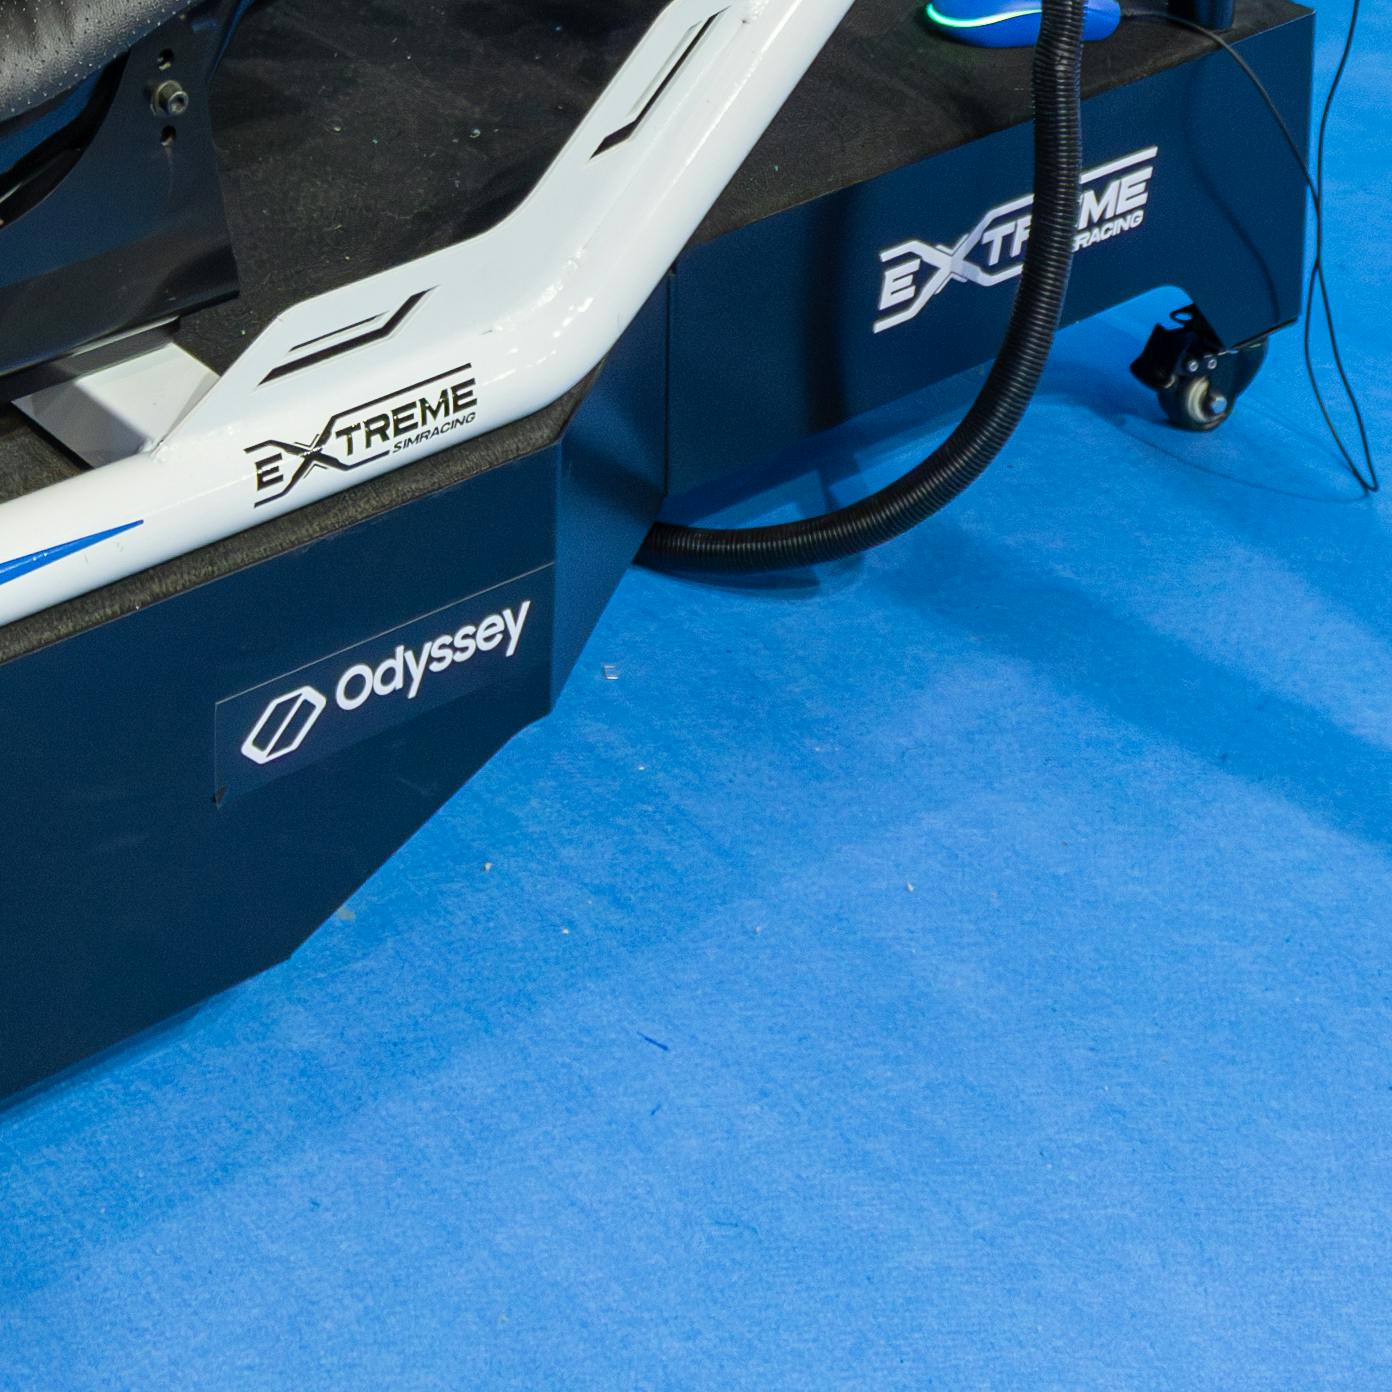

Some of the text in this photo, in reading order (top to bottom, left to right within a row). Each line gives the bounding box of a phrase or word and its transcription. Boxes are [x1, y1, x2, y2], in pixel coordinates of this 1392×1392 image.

[244, 363, 478, 508] EXTREME
[391, 411, 476, 454] SIMRACING
[335, 600, 531, 711] Odyssey
